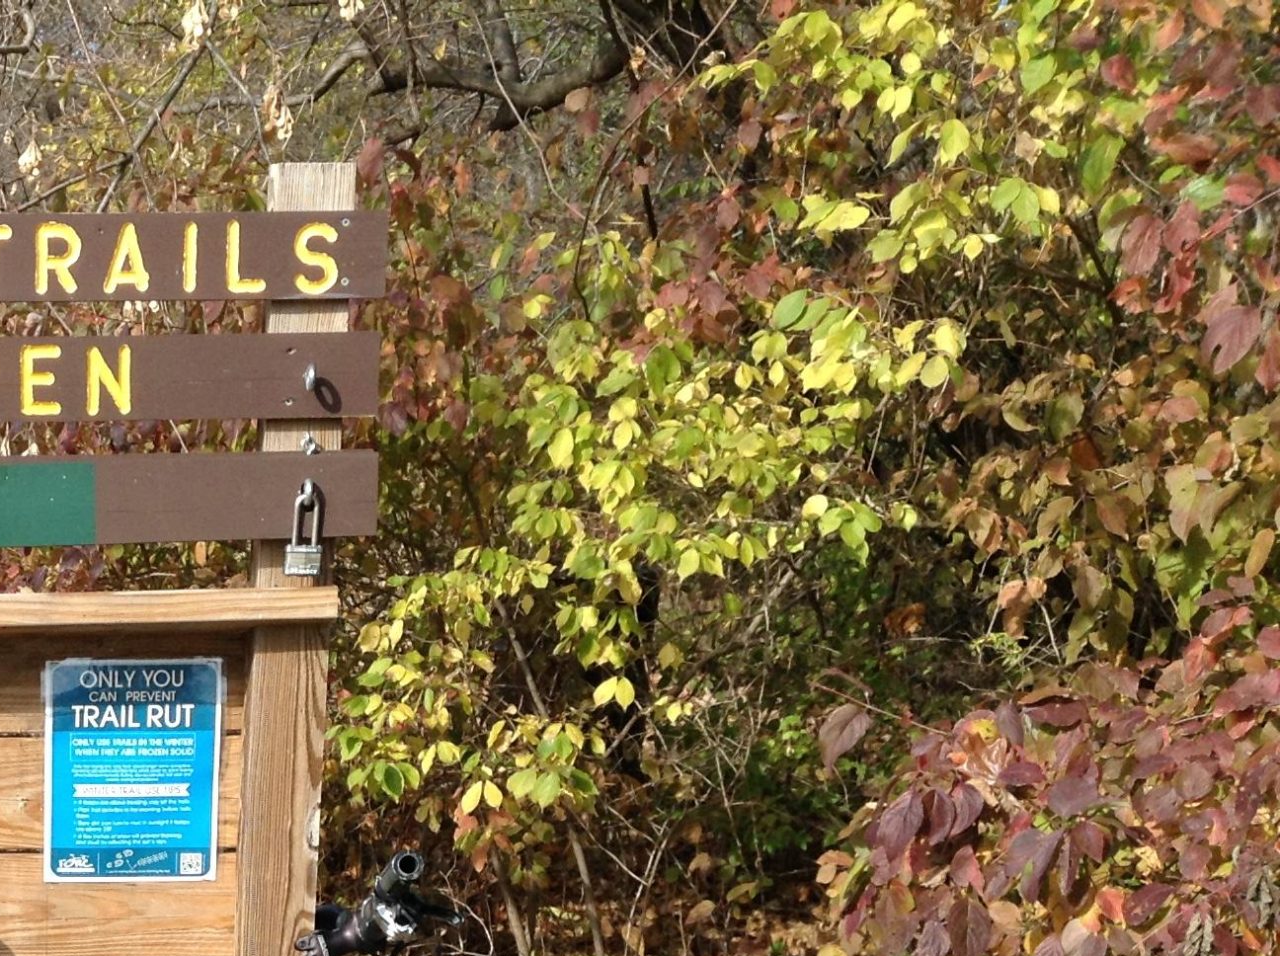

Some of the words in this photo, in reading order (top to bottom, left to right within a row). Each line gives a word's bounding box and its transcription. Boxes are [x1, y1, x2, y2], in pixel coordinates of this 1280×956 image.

[80, 670, 135, 689] ONLY
[142, 669, 184, 688] YOU
[89, 691, 117, 702] CAN
[126, 691, 176, 702] PREVENT
[71, 705, 140, 728] TRAIL
[146, 704, 195, 728] RUT
